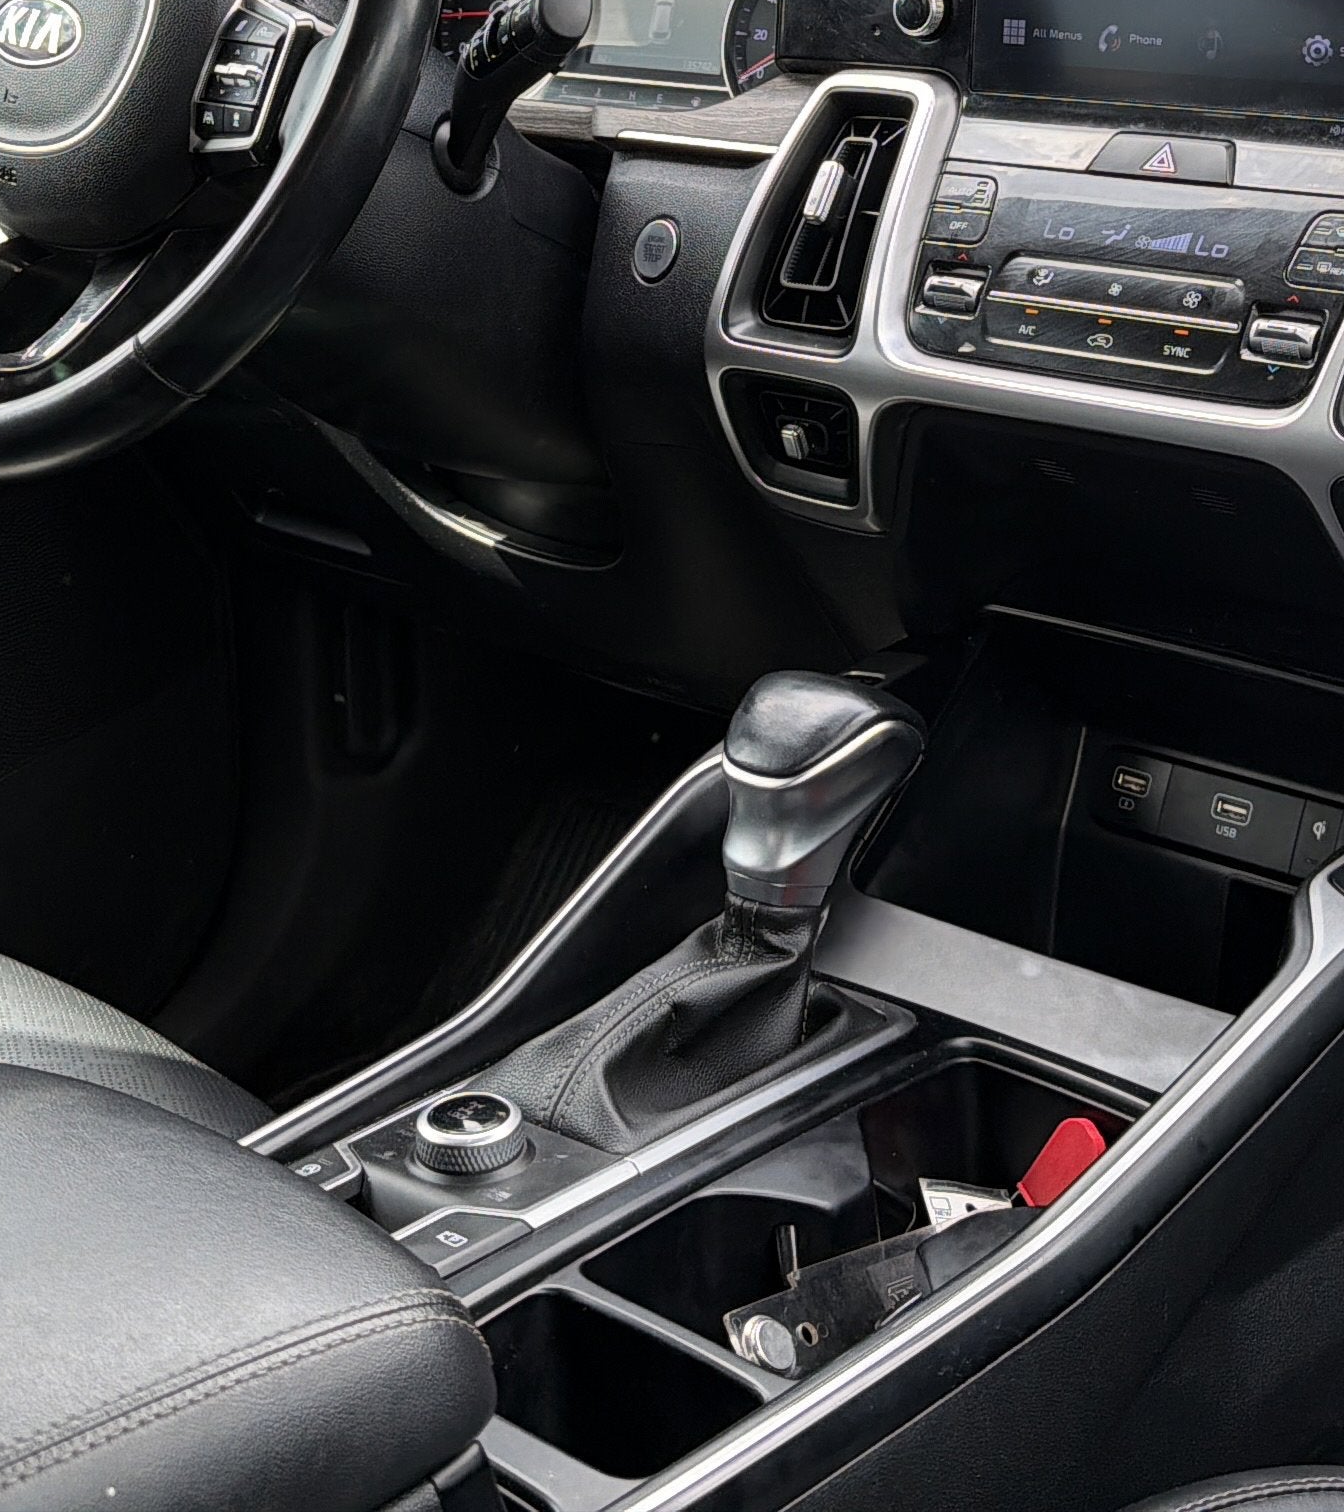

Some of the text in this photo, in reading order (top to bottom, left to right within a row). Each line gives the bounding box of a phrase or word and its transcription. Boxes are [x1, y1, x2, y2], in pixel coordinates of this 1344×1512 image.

[753, 28, 768, 41] 20
[1033, 28, 1082, 41] All Menus
[1129, 34, 1163, 46] Phone
[628, 91, 637, 102] H
[656, 94, 664, 105] E
[948, 220, 969, 230] OFF
[642, 253, 662, 263] STOP
[1018, 324, 1037, 337] A/C
[1162, 345, 1192, 359] SYNC
[1215, 824, 1238, 839] USB
